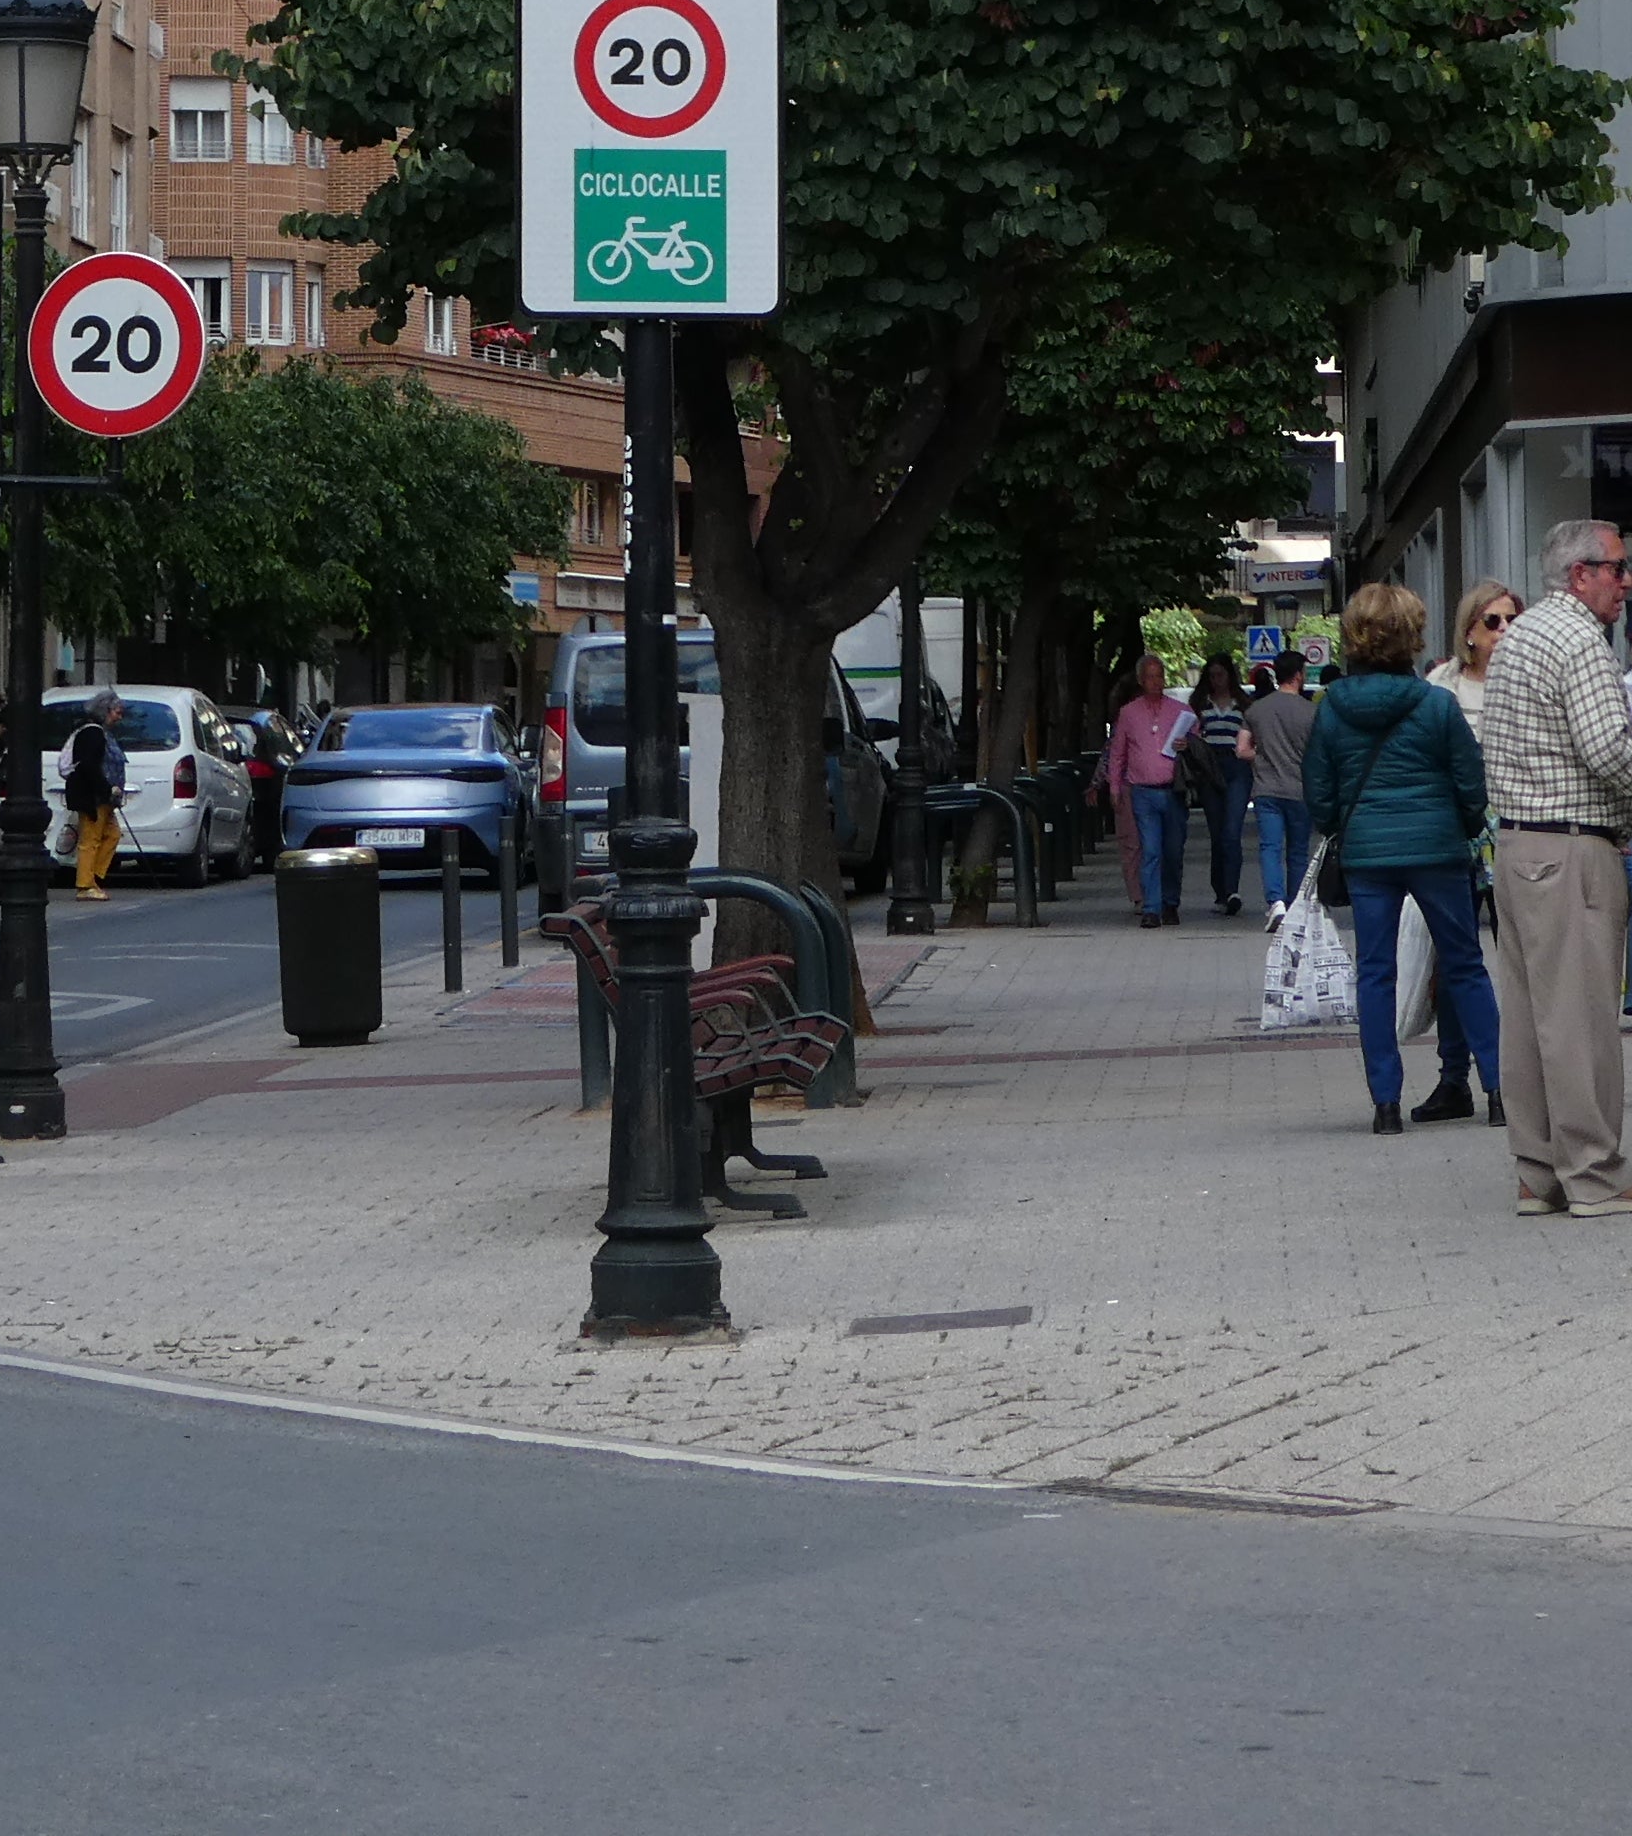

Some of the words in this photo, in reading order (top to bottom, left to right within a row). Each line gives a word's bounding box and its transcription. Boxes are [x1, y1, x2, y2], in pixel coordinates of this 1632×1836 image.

[608, 38, 691, 86] 20
[579, 172, 722, 198] CICLOCALLE
[70, 314, 163, 374] 20
